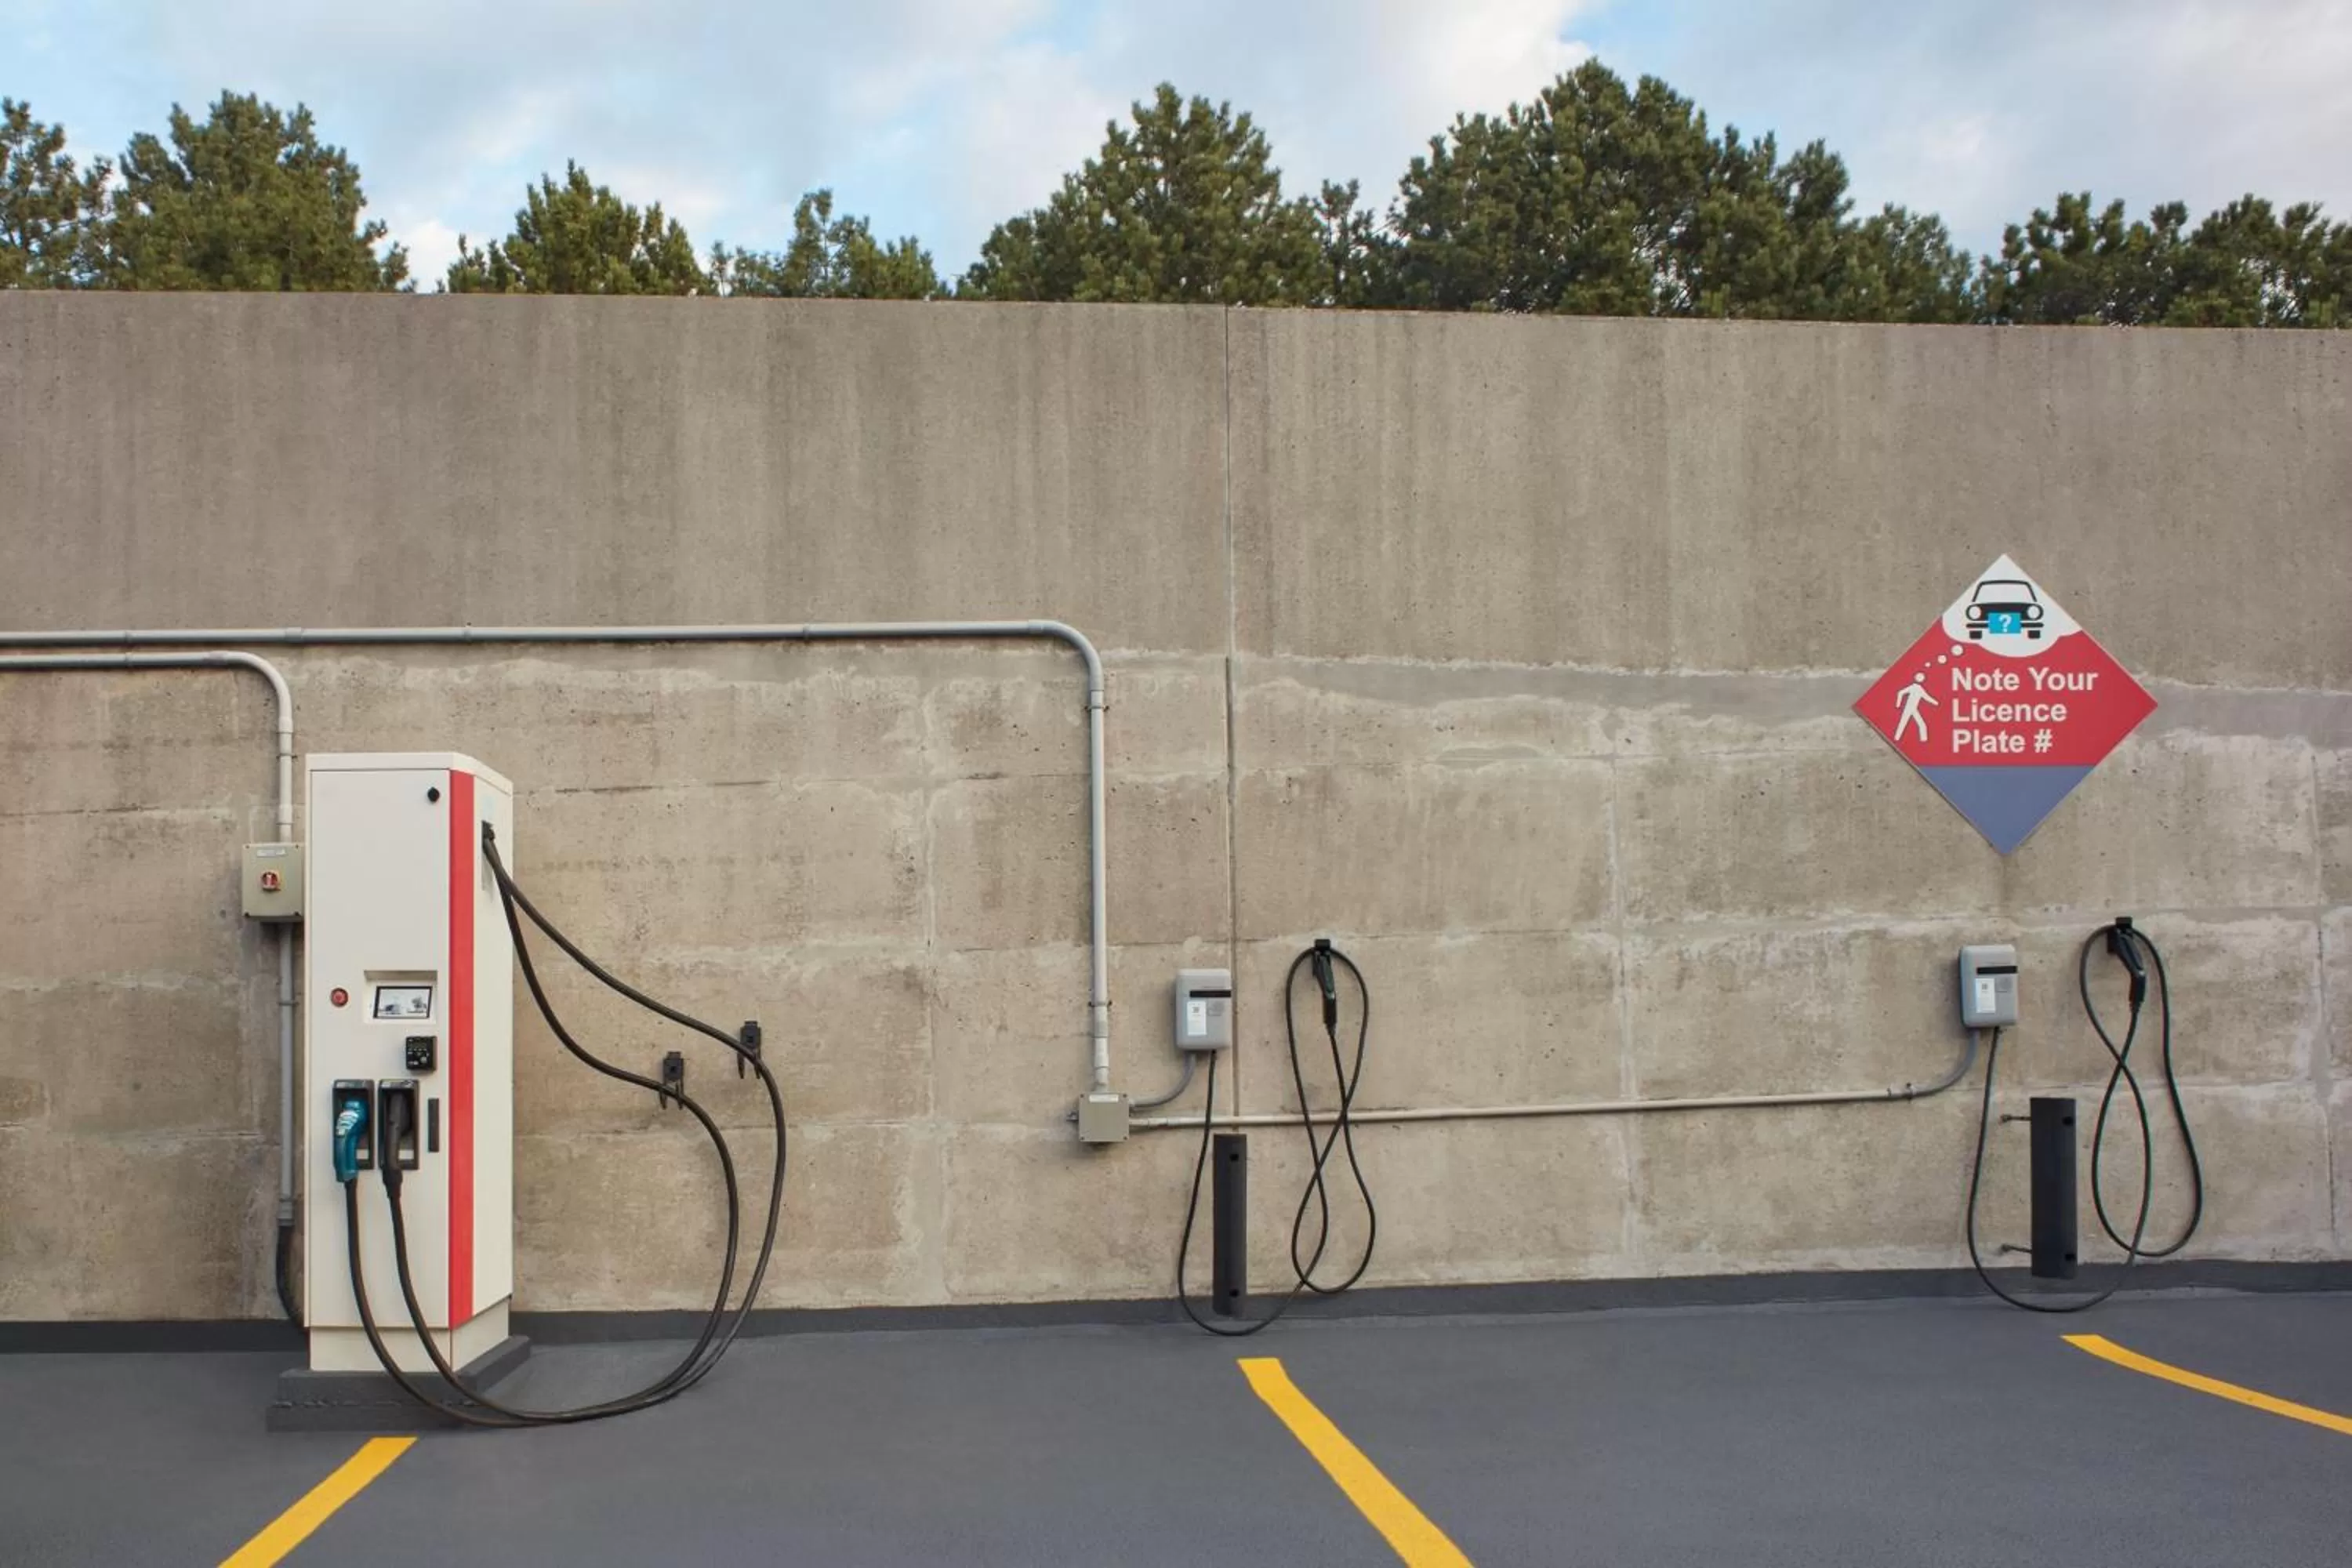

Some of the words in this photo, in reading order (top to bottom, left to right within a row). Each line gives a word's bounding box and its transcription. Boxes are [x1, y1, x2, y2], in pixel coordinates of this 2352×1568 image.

[1998, 614, 2013, 633] ?
[1952, 667, 2020, 691] Note
[2028, 667, 2099, 691] Your
[1952, 699, 2067, 722] Licence
[1953, 729, 2026, 753] Plate
[2034, 729, 2053, 753] #
